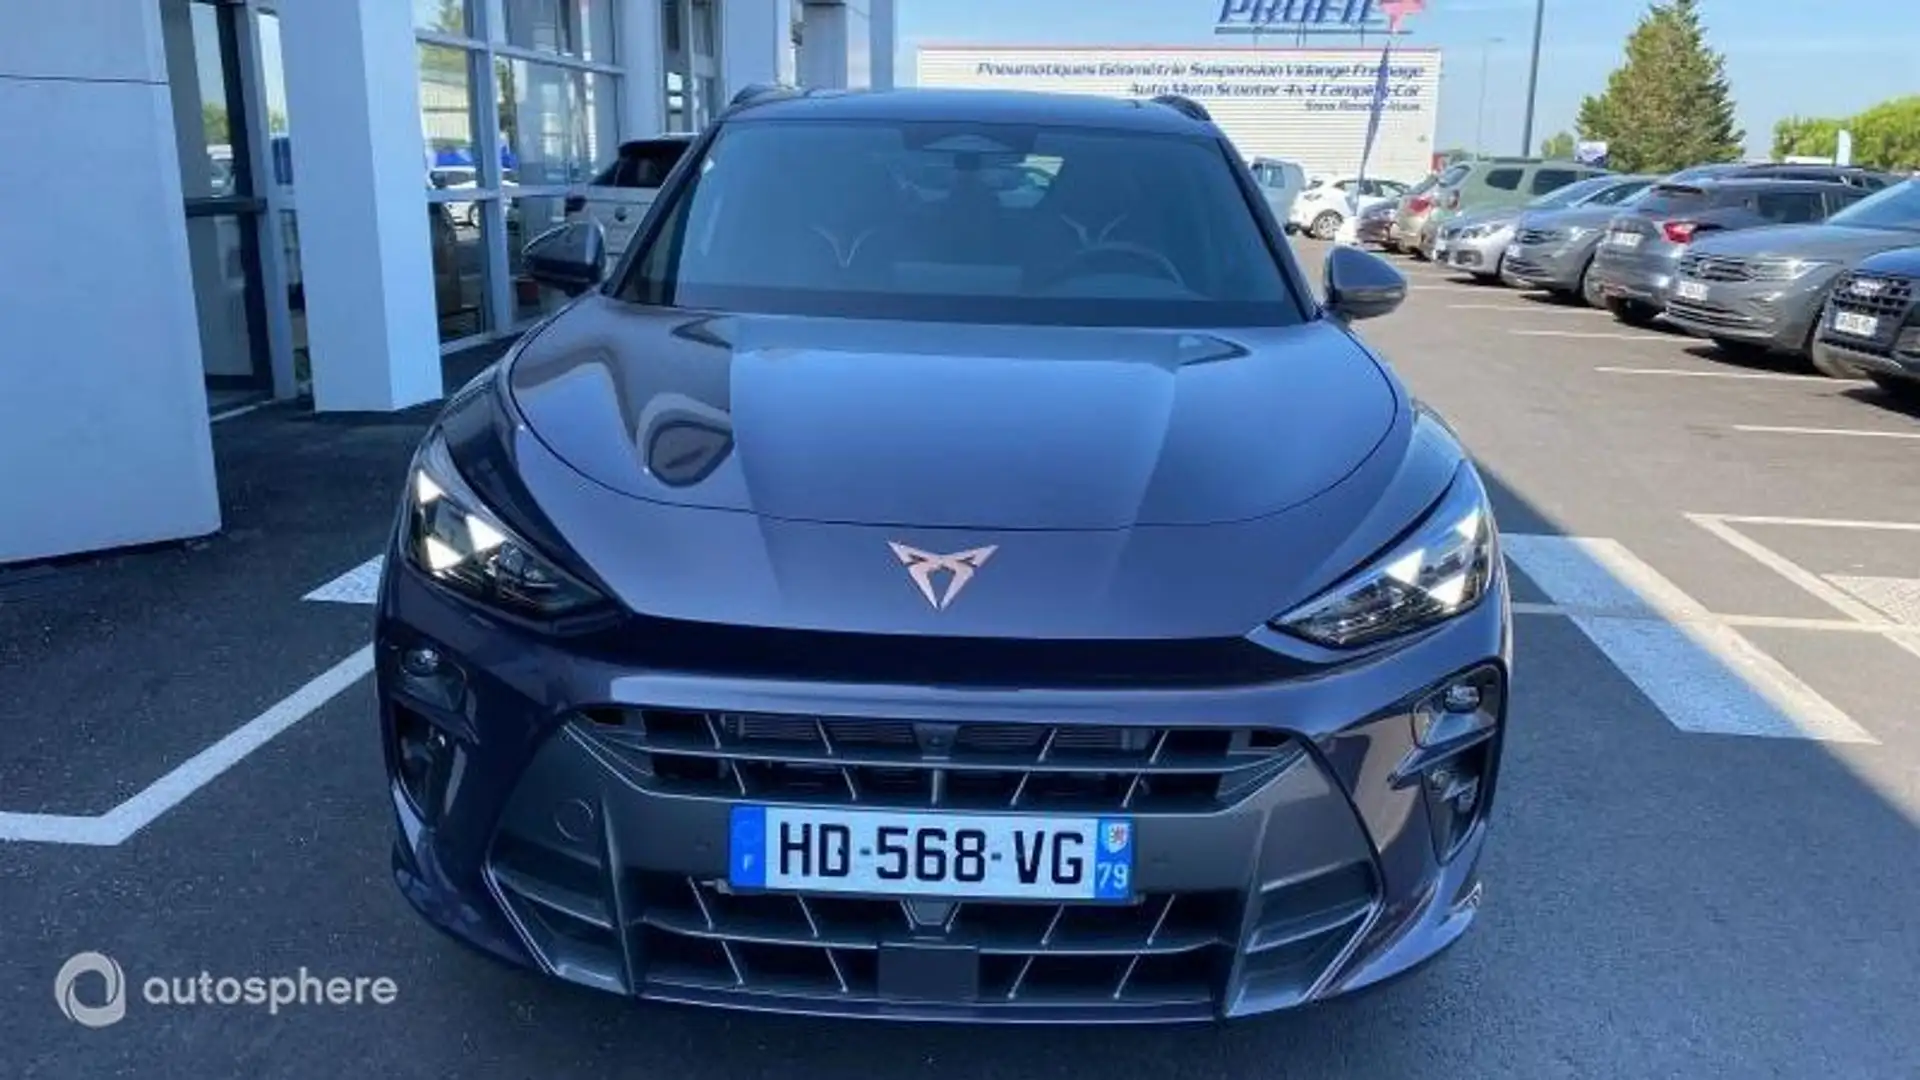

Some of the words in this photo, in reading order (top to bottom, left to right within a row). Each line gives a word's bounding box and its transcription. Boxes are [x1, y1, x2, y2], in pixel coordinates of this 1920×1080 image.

[1189, 62, 1282, 78] Suspension
[1127, 83, 1168, 95] Auto
[1216, 83, 1279, 97] Scooter
[779, 821, 1085, 885] HD-568-VG
[1098, 862, 1130, 890] 79
